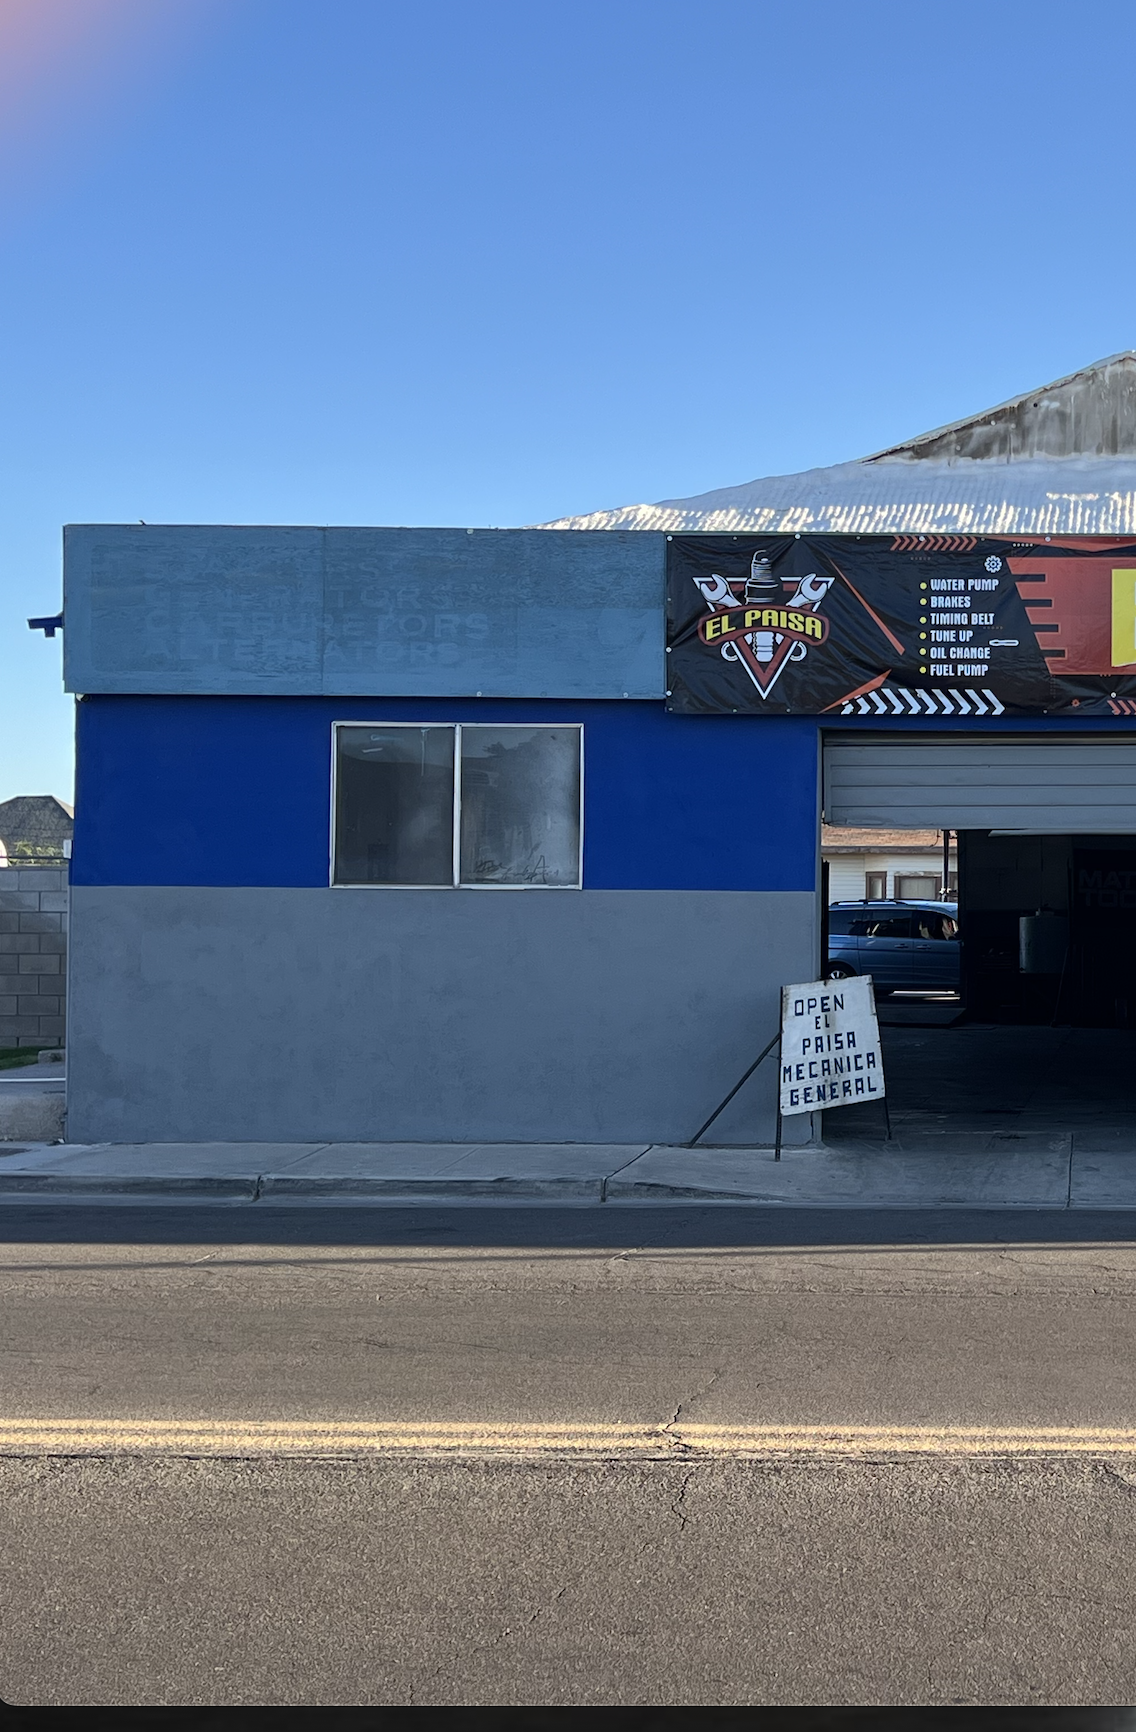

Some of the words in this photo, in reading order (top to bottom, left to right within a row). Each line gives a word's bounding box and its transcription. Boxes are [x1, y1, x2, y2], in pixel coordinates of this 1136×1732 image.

[930, 579, 965, 591] WATER
[968, 579, 999, 591] PUMP
[930, 596, 971, 608] BRAKES
[705, 614, 736, 641] EL
[744, 609, 822, 640] PAISA
[930, 613, 968, 625] TIMING
[971, 613, 995, 625] BELT
[930, 630, 956, 642] TUNE
[959, 630, 973, 642] UP
[930, 647, 947, 659] OIL
[949, 647, 990, 659] CHANGE
[930, 664, 955, 676] FUEL
[957, 664, 988, 676] PUMP
[794, 994, 844, 1016] OPEN
[815, 1014, 830, 1030] EL
[802, 1031, 856, 1055] PAISA
[783, 1052, 876, 1083] MECANICA
[790, 1076, 877, 1106] GENERAL
